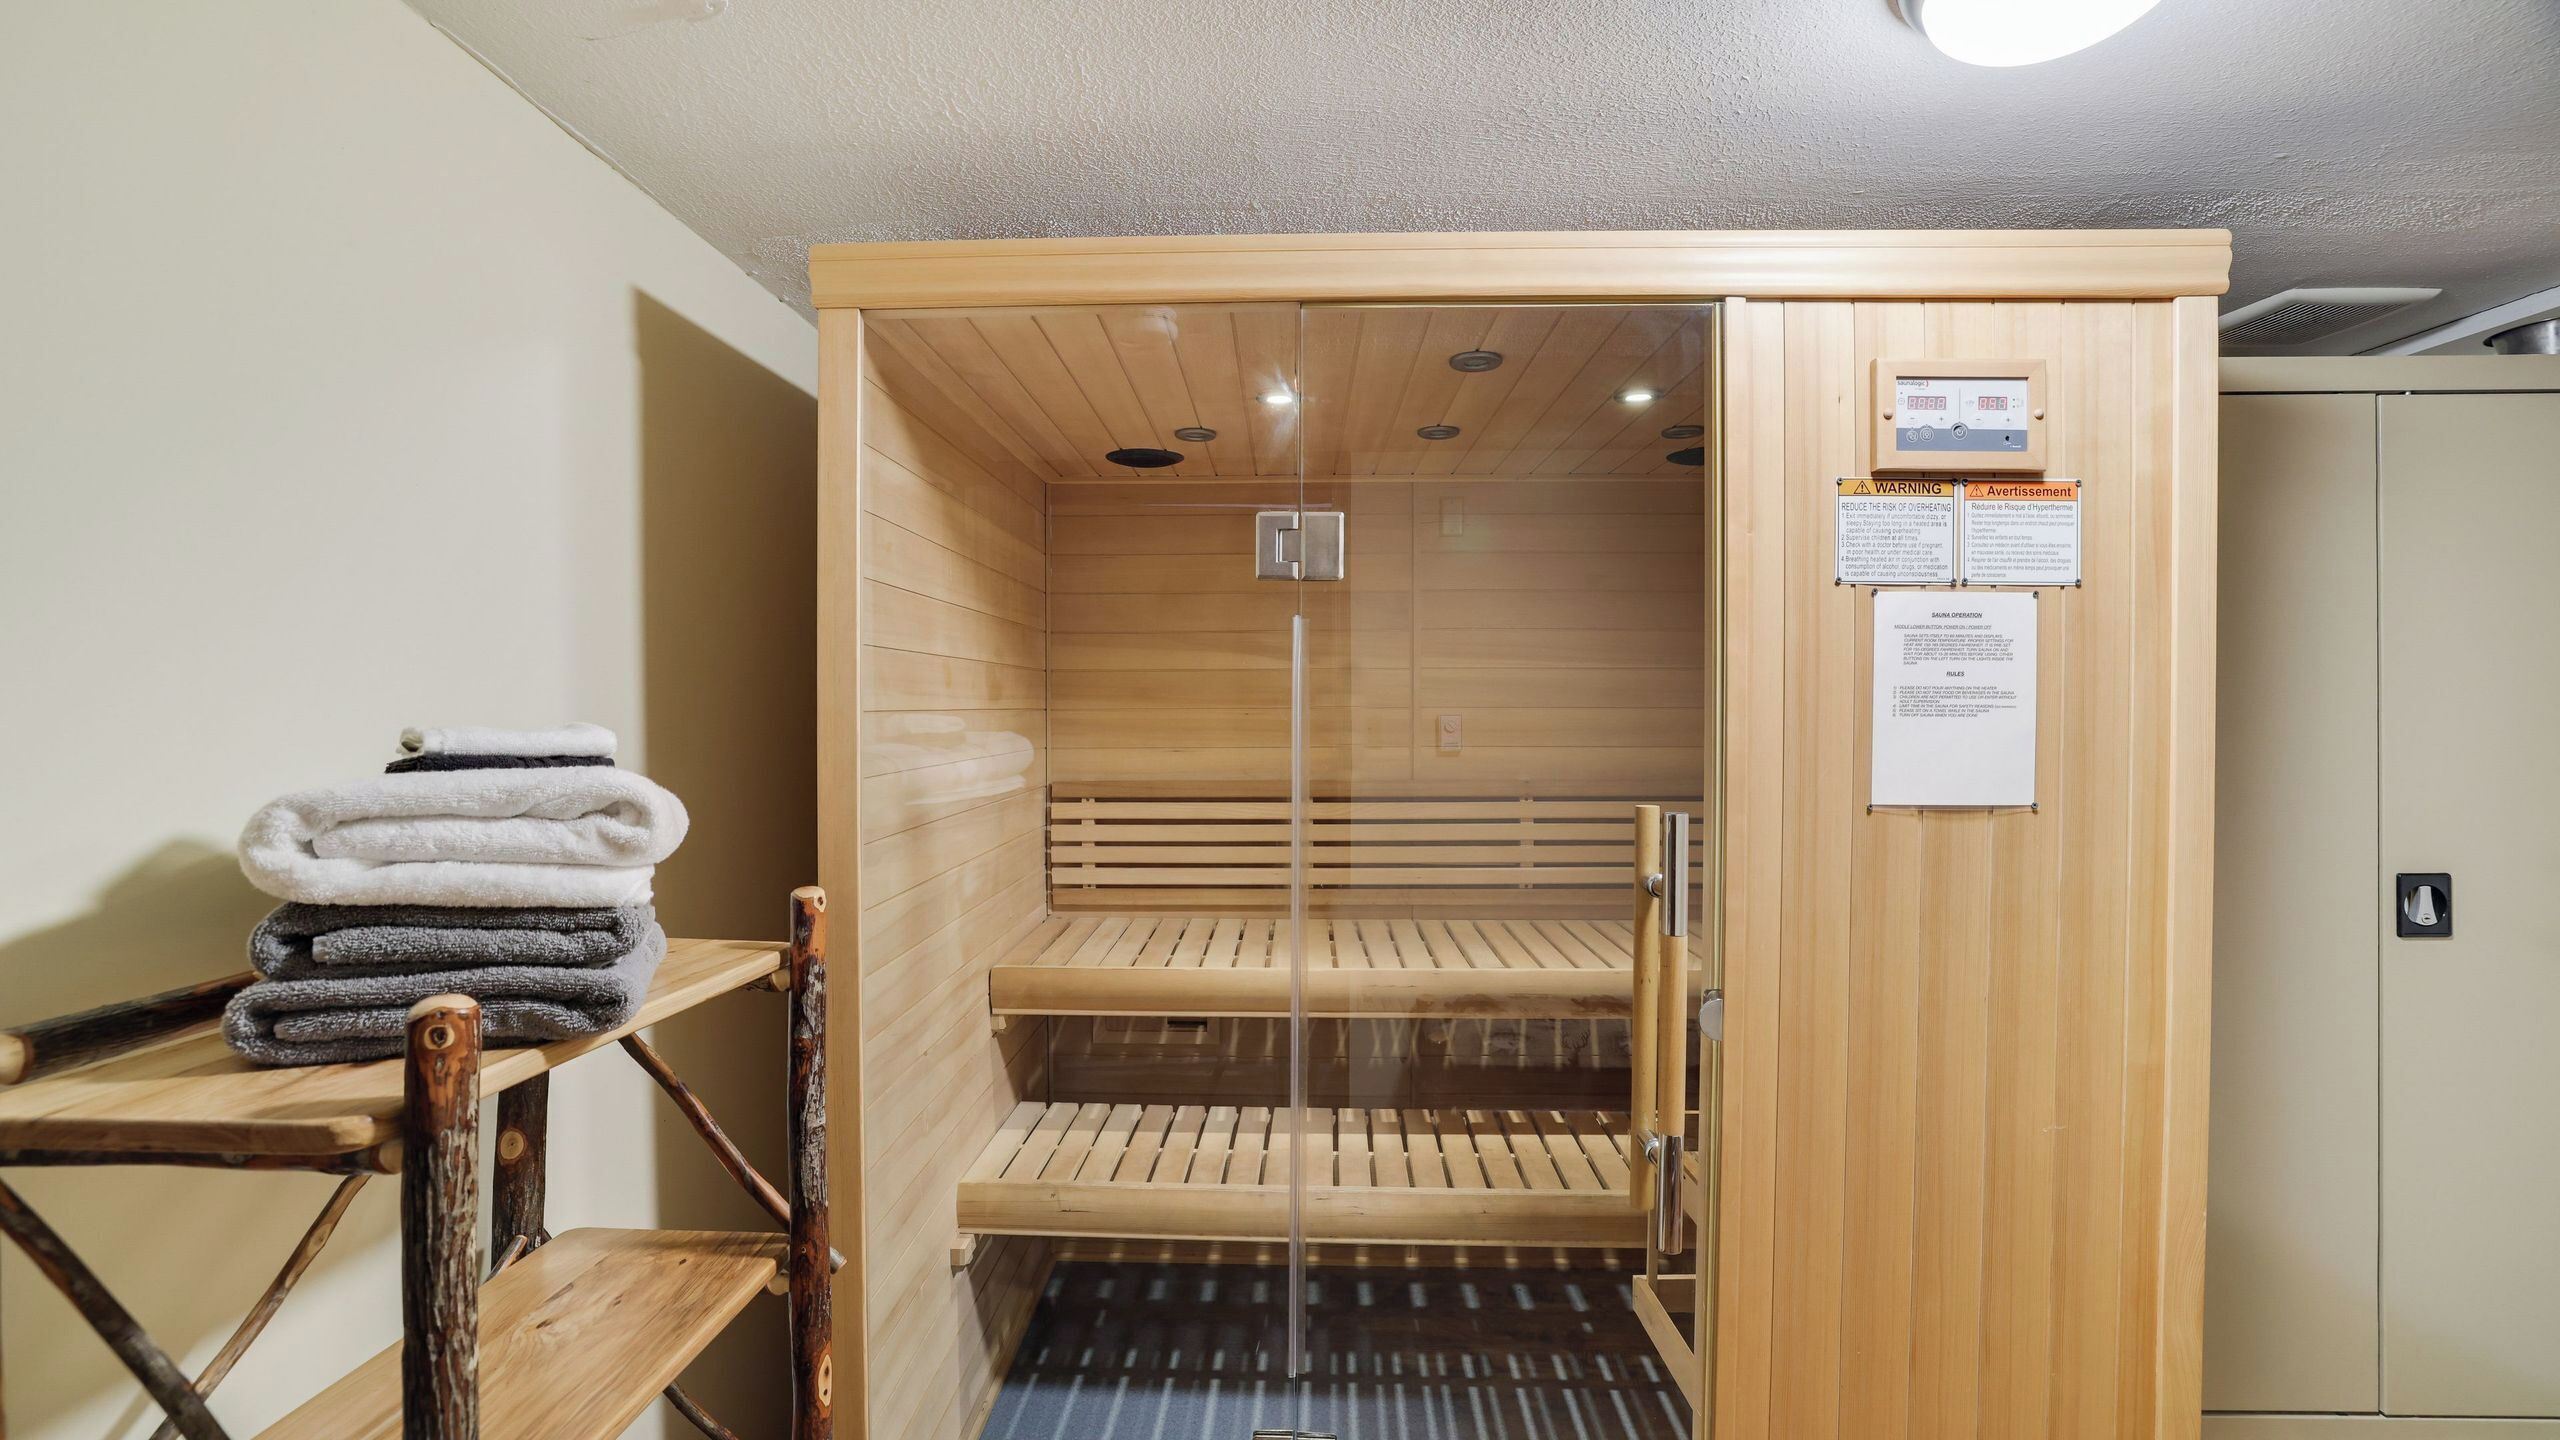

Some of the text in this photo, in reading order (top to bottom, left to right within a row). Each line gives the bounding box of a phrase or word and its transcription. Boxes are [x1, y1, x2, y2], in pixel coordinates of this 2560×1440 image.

[1875, 482, 1942, 494] WARNING
[1987, 485, 2071, 497] Avertissement
[1842, 503, 1952, 512] REDUCE THE RISK OF OVERHEATING
[2004, 503, 2026, 512] Risque
